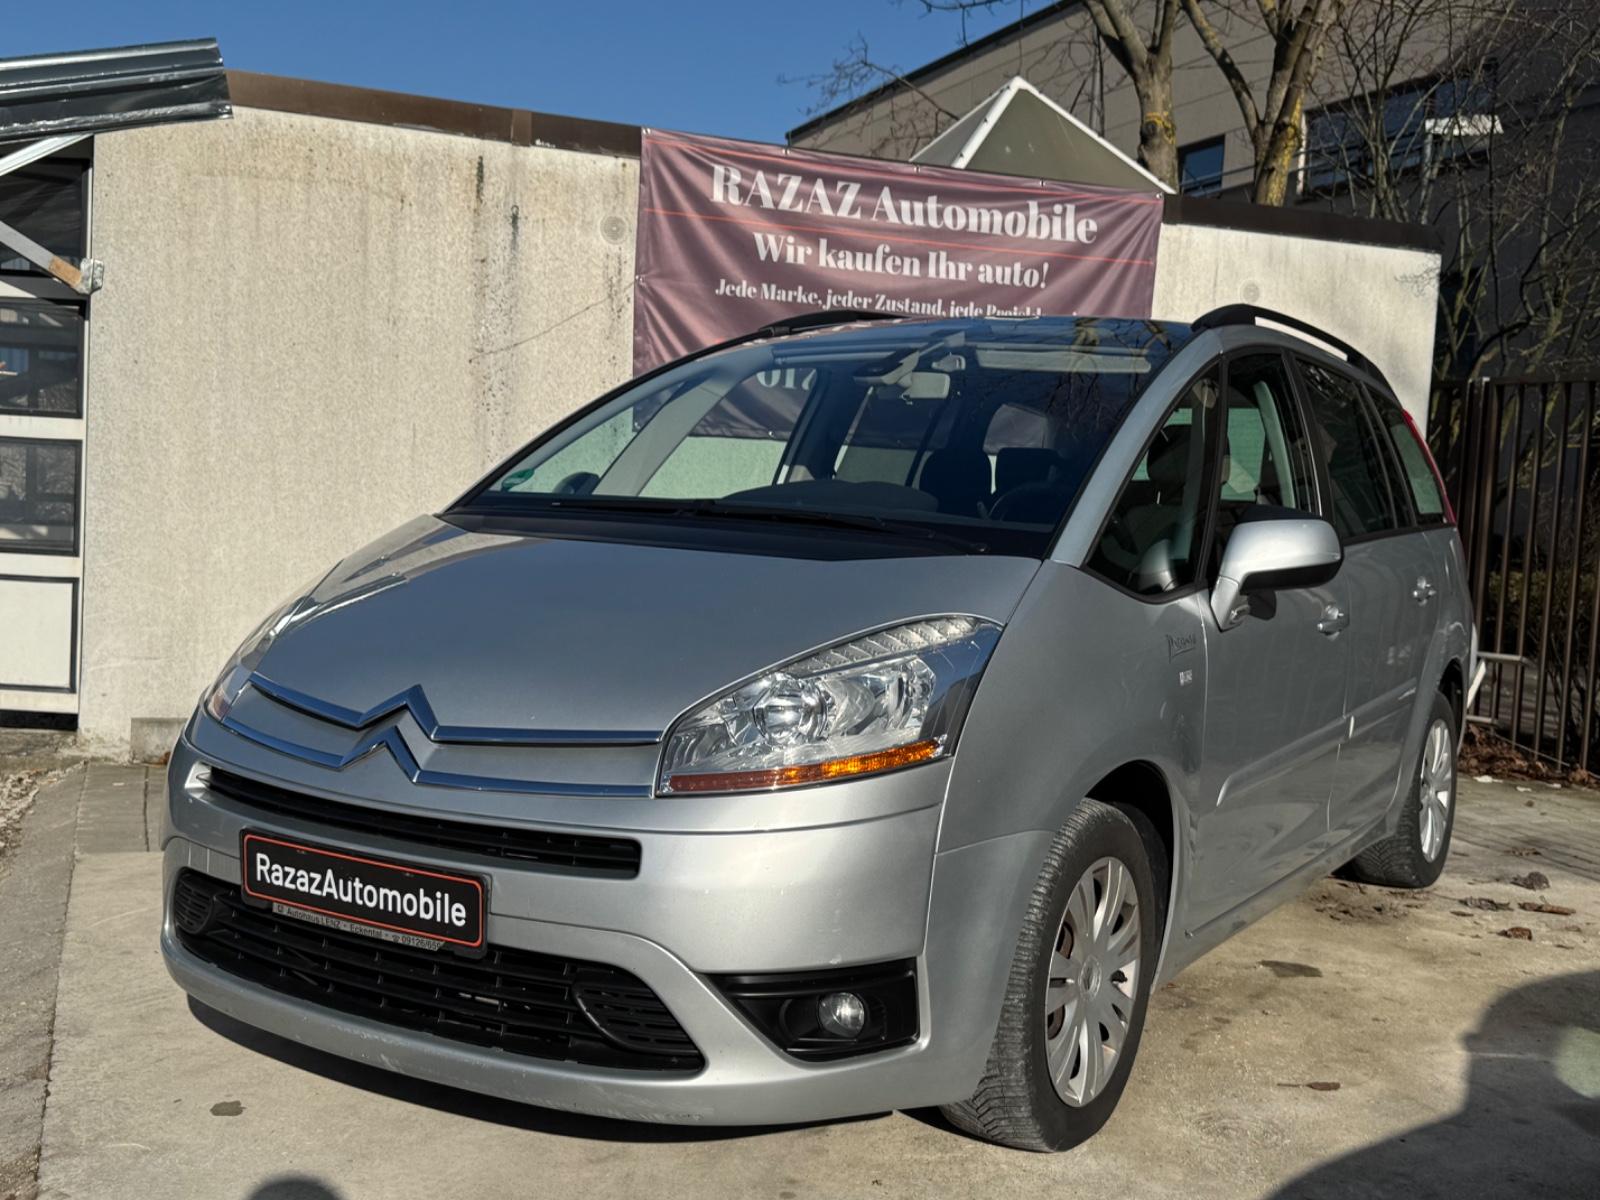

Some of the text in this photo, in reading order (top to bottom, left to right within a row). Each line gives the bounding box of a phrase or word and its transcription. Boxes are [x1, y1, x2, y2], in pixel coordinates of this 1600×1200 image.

[710, 164, 1098, 244] RAZAZ Automobile
[753, 232, 1049, 289] Wir kaufen Ihr auto!
[715, 279, 757, 298] Jede
[761, 283, 822, 305] Marke,
[822, 289, 872, 310] jeder
[875, 293, 947, 317] Zustand,
[255, 852, 467, 928] RazazAutomobile
